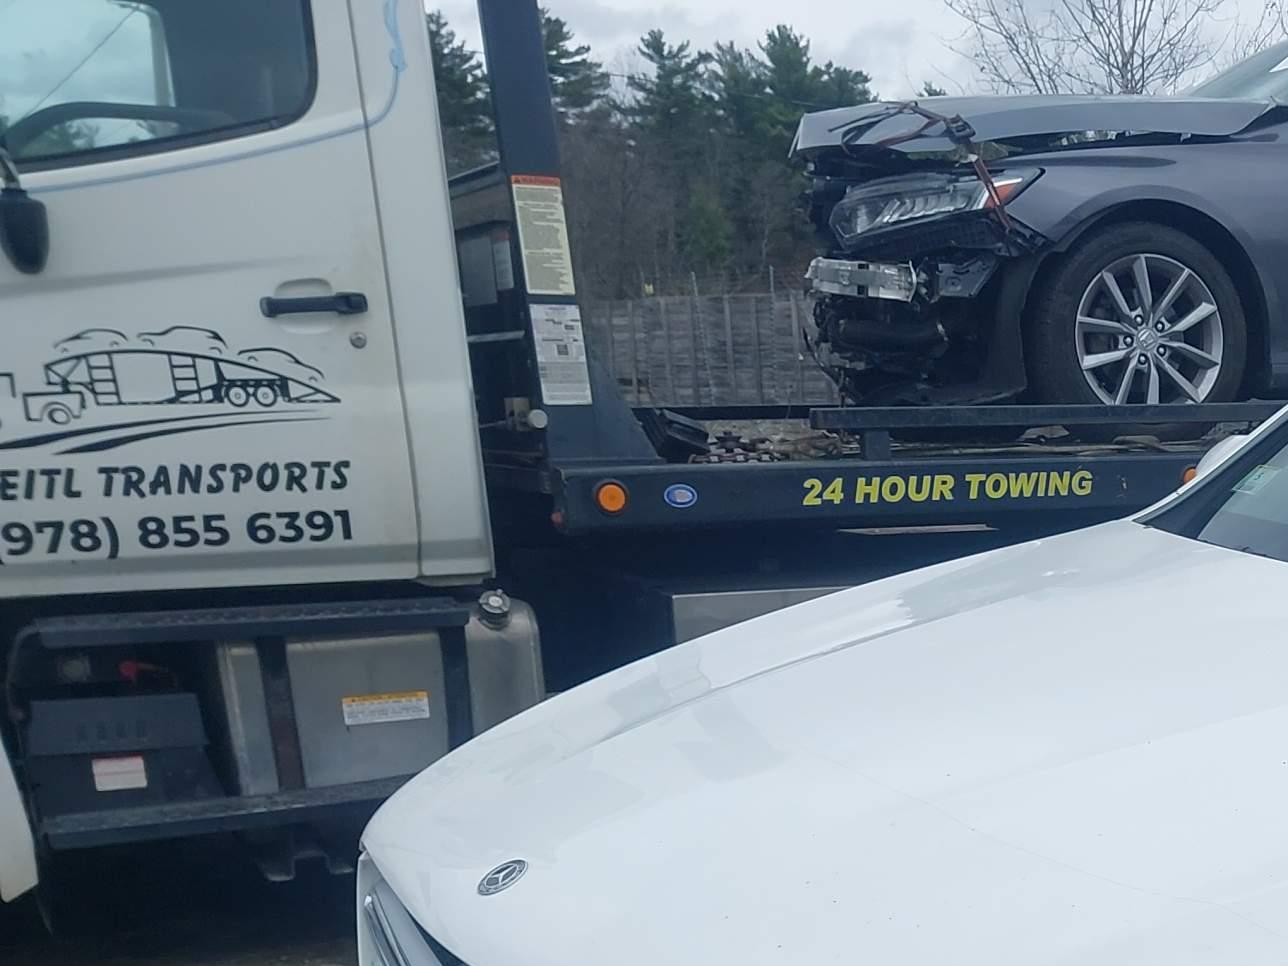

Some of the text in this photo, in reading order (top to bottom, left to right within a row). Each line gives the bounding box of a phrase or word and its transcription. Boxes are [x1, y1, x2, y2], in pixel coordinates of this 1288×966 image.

[98, 460, 351, 498] TRANSPORTS
[802, 471, 1093, 506] 24 HOUR TOWING
[137, 513, 231, 550] 855
[245, 509, 353, 545] 6391
